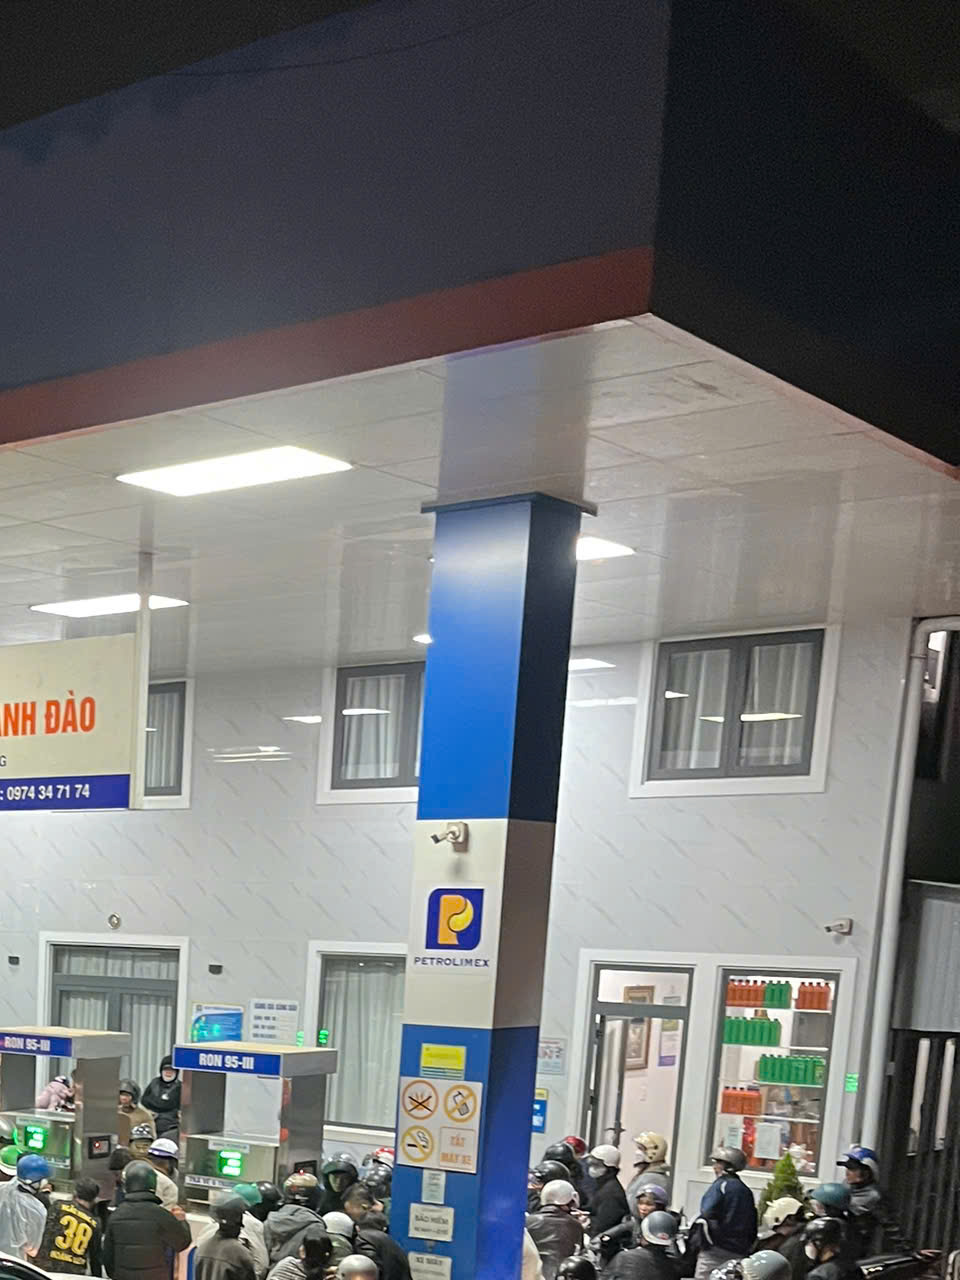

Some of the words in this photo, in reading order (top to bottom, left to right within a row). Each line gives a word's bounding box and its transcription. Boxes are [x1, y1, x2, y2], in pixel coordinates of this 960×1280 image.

[44, 690, 96, 735] ĐÀO
[6, 785, 35, 800] 0974
[39, 785, 53, 800] 34
[56, 784, 71, 799] 71
[75, 783, 90, 798] 74
[414, 956, 490, 969] PETROLIMEX
[4, 1037, 25, 1050] RON
[26, 1038, 51, 1052] 95-III
[199, 1054, 222, 1067] RON
[225, 1055, 255, 1070] 95-III
[55, 1215, 93, 1256] 38
